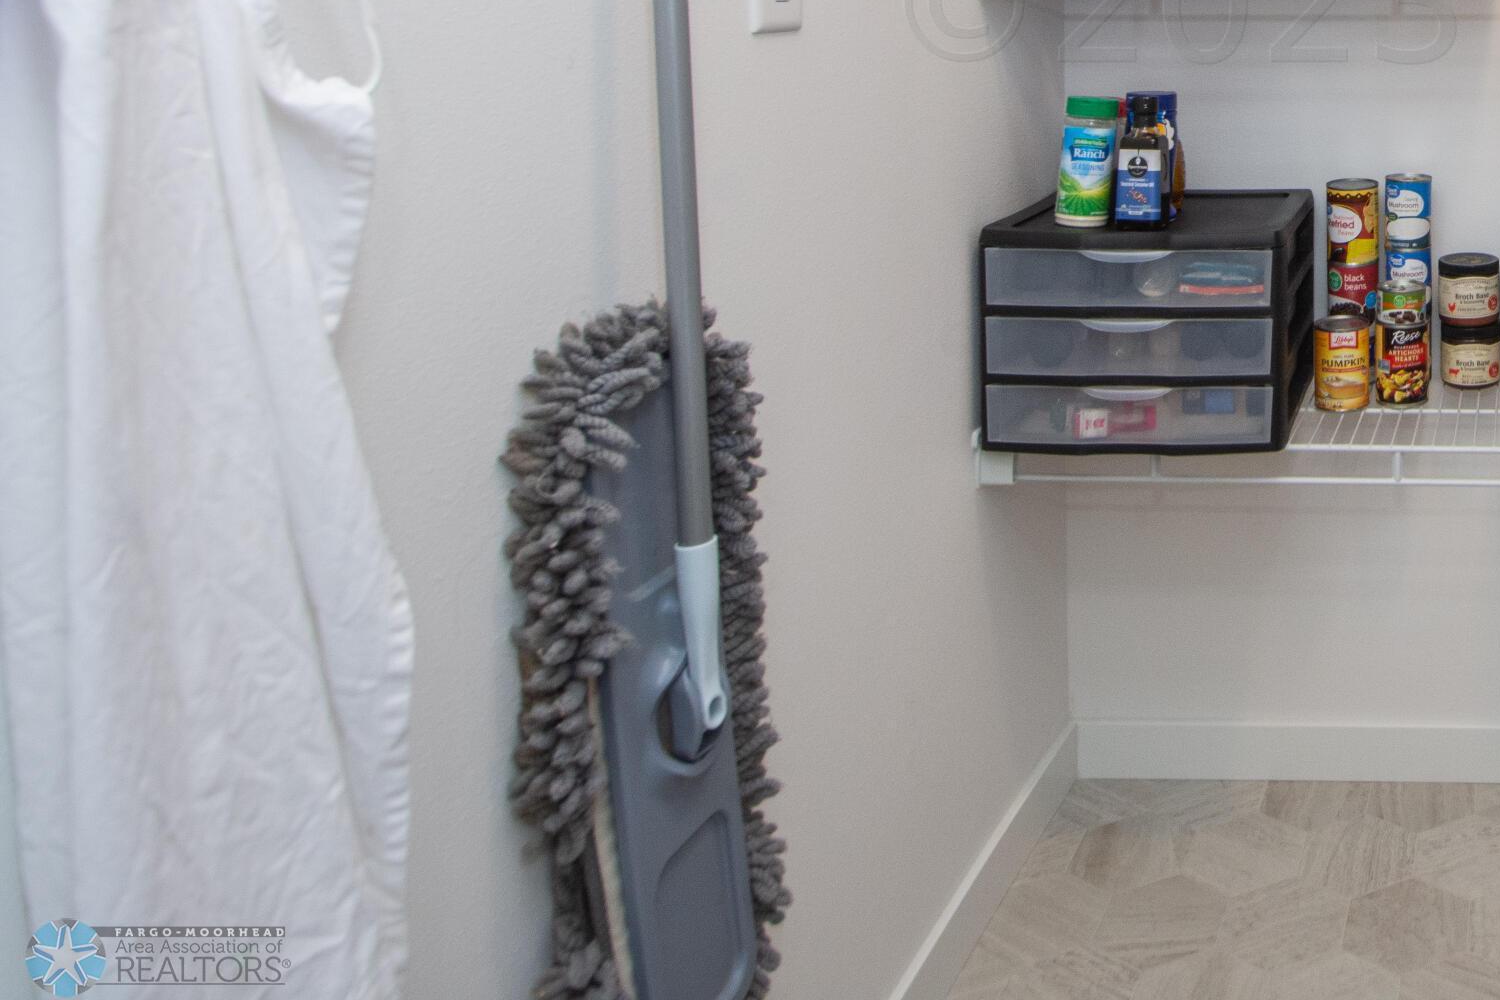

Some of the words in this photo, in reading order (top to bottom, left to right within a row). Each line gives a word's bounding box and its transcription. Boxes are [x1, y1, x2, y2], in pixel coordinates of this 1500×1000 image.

[1073, 148, 1106, 159] Ranch
[1344, 274, 1365, 282] black
[1344, 283, 1367, 291] beans
[1391, 329, 1420, 345] Reese
[1321, 358, 1366, 368] PUMPKIN
